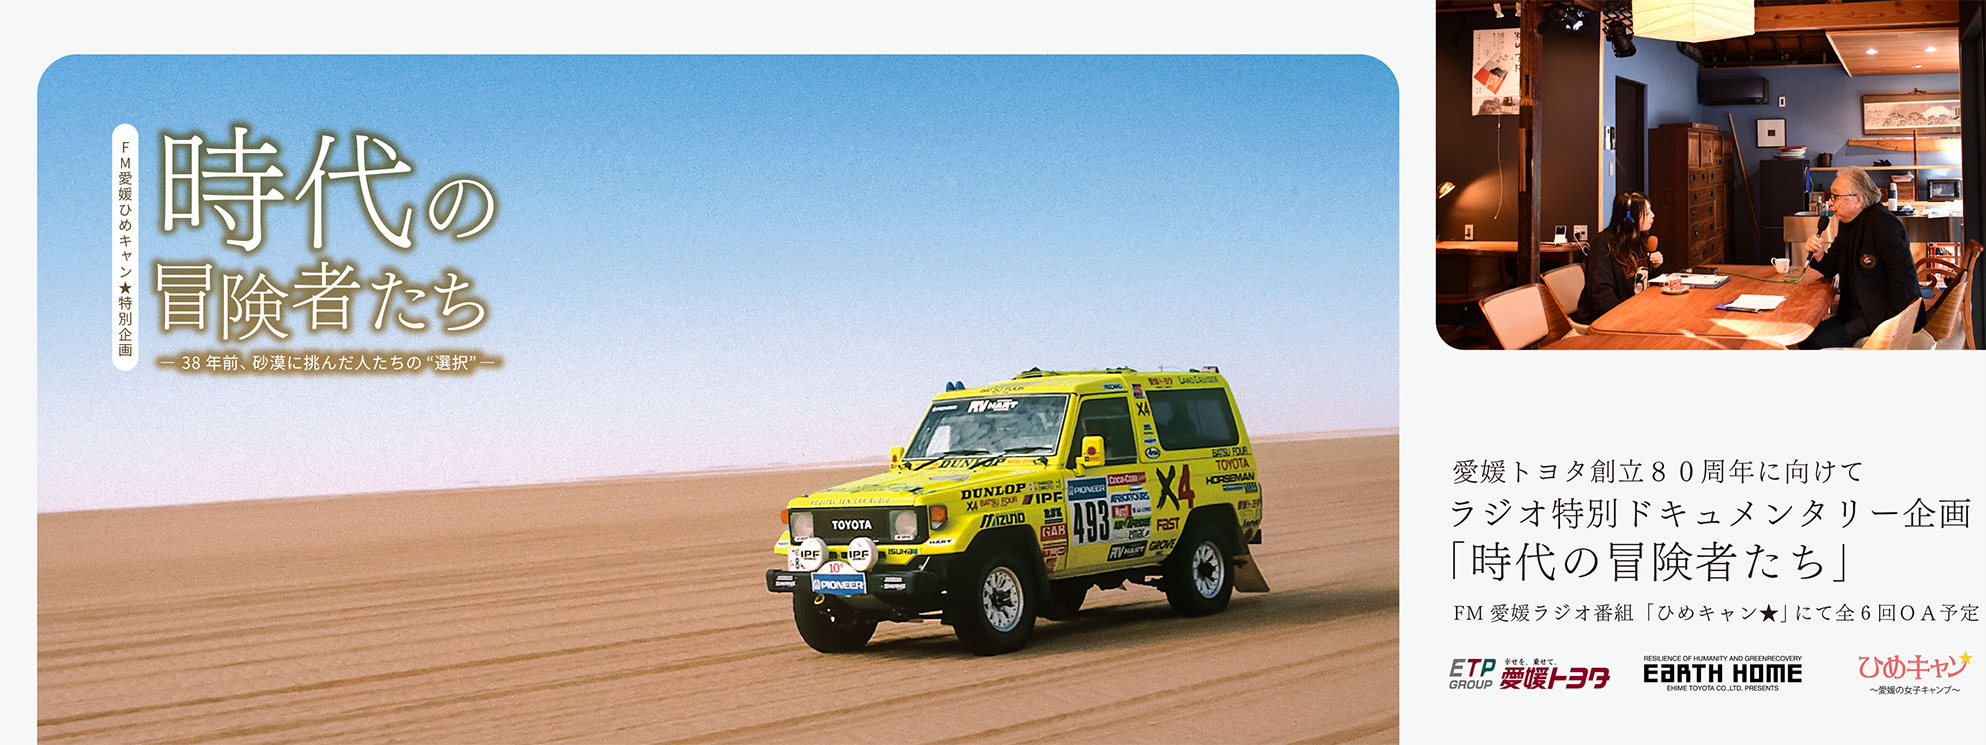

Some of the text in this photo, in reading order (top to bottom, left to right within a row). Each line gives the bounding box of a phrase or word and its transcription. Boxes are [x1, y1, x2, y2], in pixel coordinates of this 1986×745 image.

[1136, 401, 1151, 417] X4
[1215, 458, 1250, 471] TOYOTA
[1206, 472, 1255, 485] HORSEMAN
[961, 483, 1026, 500] DUNLOP
[1074, 484, 1105, 494] PIONEER
[1156, 464, 1196, 511] X4
[1036, 491, 1063, 504] IPF
[832, 520, 873, 530] TOYOTA
[1073, 500, 1110, 544] 493
[1042, 525, 1066, 538] GAB
[801, 550, 821, 558] IPF
[849, 550, 869, 558] IPF
[821, 580, 864, 590] PIONEER
